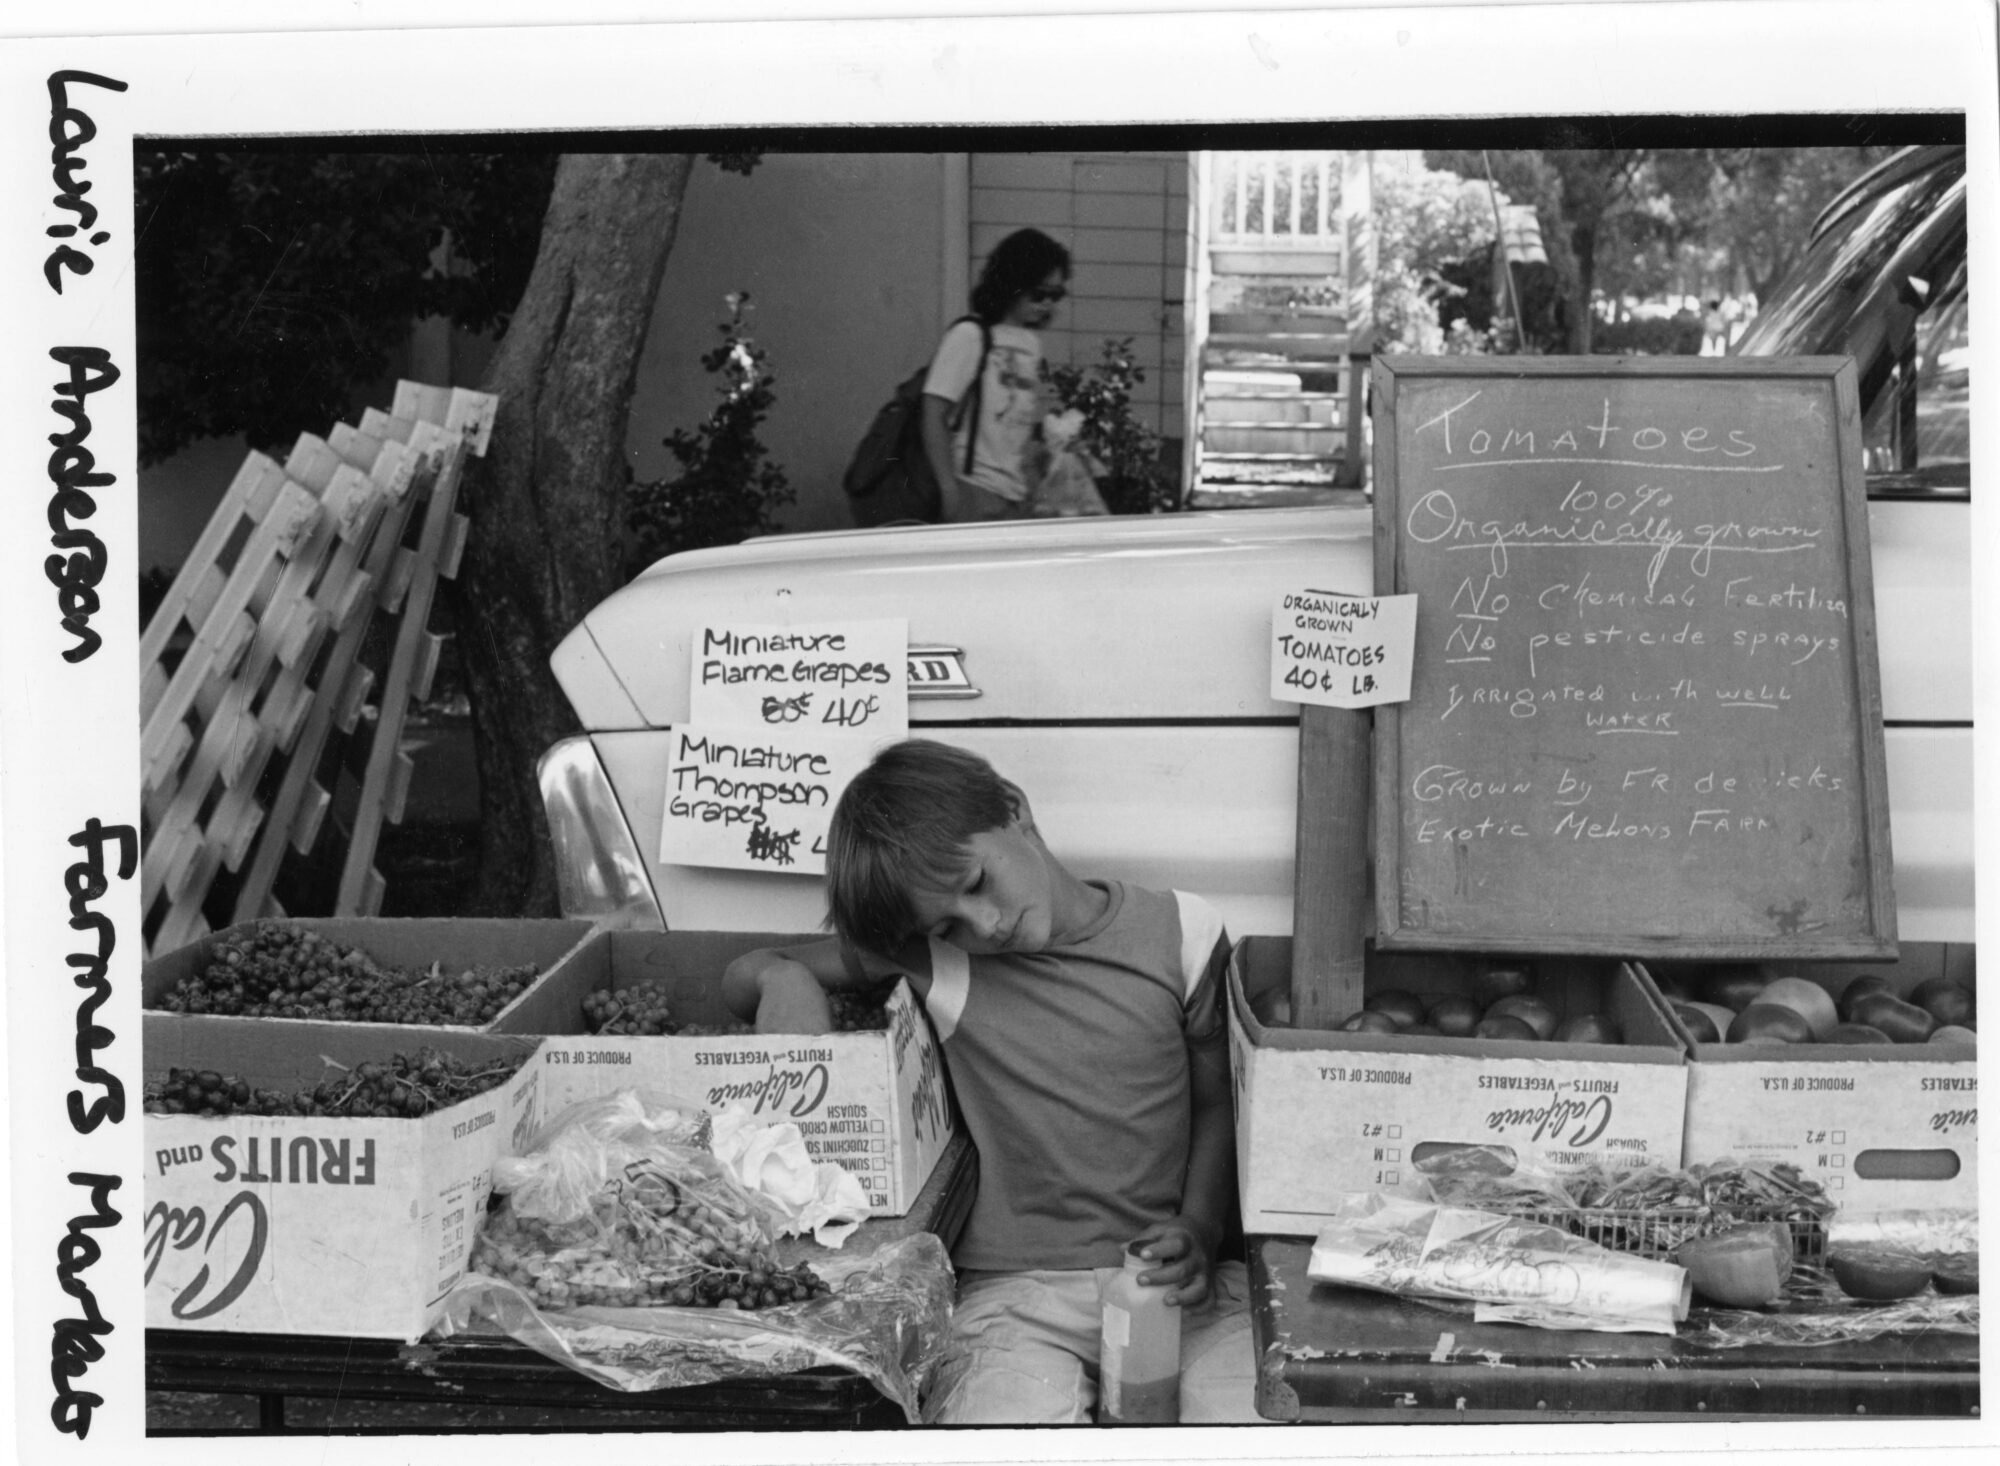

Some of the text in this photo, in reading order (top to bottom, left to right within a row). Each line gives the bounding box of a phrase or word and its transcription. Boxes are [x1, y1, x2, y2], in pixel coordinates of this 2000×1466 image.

[44, 69, 128, 295] Laurie
[45, 346, 120, 663] Anderson
[1560, 480, 1673, 515] 100%
[1407, 490, 1683, 588] Organically
[1283, 594, 1379, 620] ORGANICALLY
[1295, 615, 1352, 633] GROWN
[703, 627, 846, 656] Miniature
[1278, 634, 1385, 667] TOMATOES
[1529, 622, 1705, 678] pesticide
[702, 660, 891, 688] Flame Grapes
[907, 660, 950, 681] RD
[1284, 665, 1332, 692] 40¢
[680, 734, 831, 776] Miniature
[673, 766, 829, 807] Thompson
[1553, 768, 1592, 805] by
[670, 796, 767, 826] Grapes
[572, 1051, 584, 1065] OF
[587, 1051, 632, 1065] PRODUCE
[695, 1052, 770, 1065] VEGETABLES
[788, 1049, 833, 1062] FRUITS
[1350, 1069, 1362, 1083] OF
[1365, 1071, 1412, 1085] PRODUCE
[1478, 1075, 1556, 1091] VEGETABLES
[1573, 1079, 1619, 1094] FRUITS
[1792, 1077, 1804, 1091] OF
[1807, 1077, 1854, 1091] PRODUCE
[706, 1063, 829, 1117] California
[827, 1105, 867, 1119] SQUASH
[1485, 1092, 1612, 1147] California
[829, 1120, 869, 1134] YELLOW
[823, 1140, 870, 1153] ZUCCHINI
[1374, 1147, 1384, 1161] M
[156, 1136, 376, 1186] FRUITS and
[1818, 1154, 1828, 1167] M
[870, 1194, 888, 1207] NET
[144, 1191, 268, 1320] Cal
